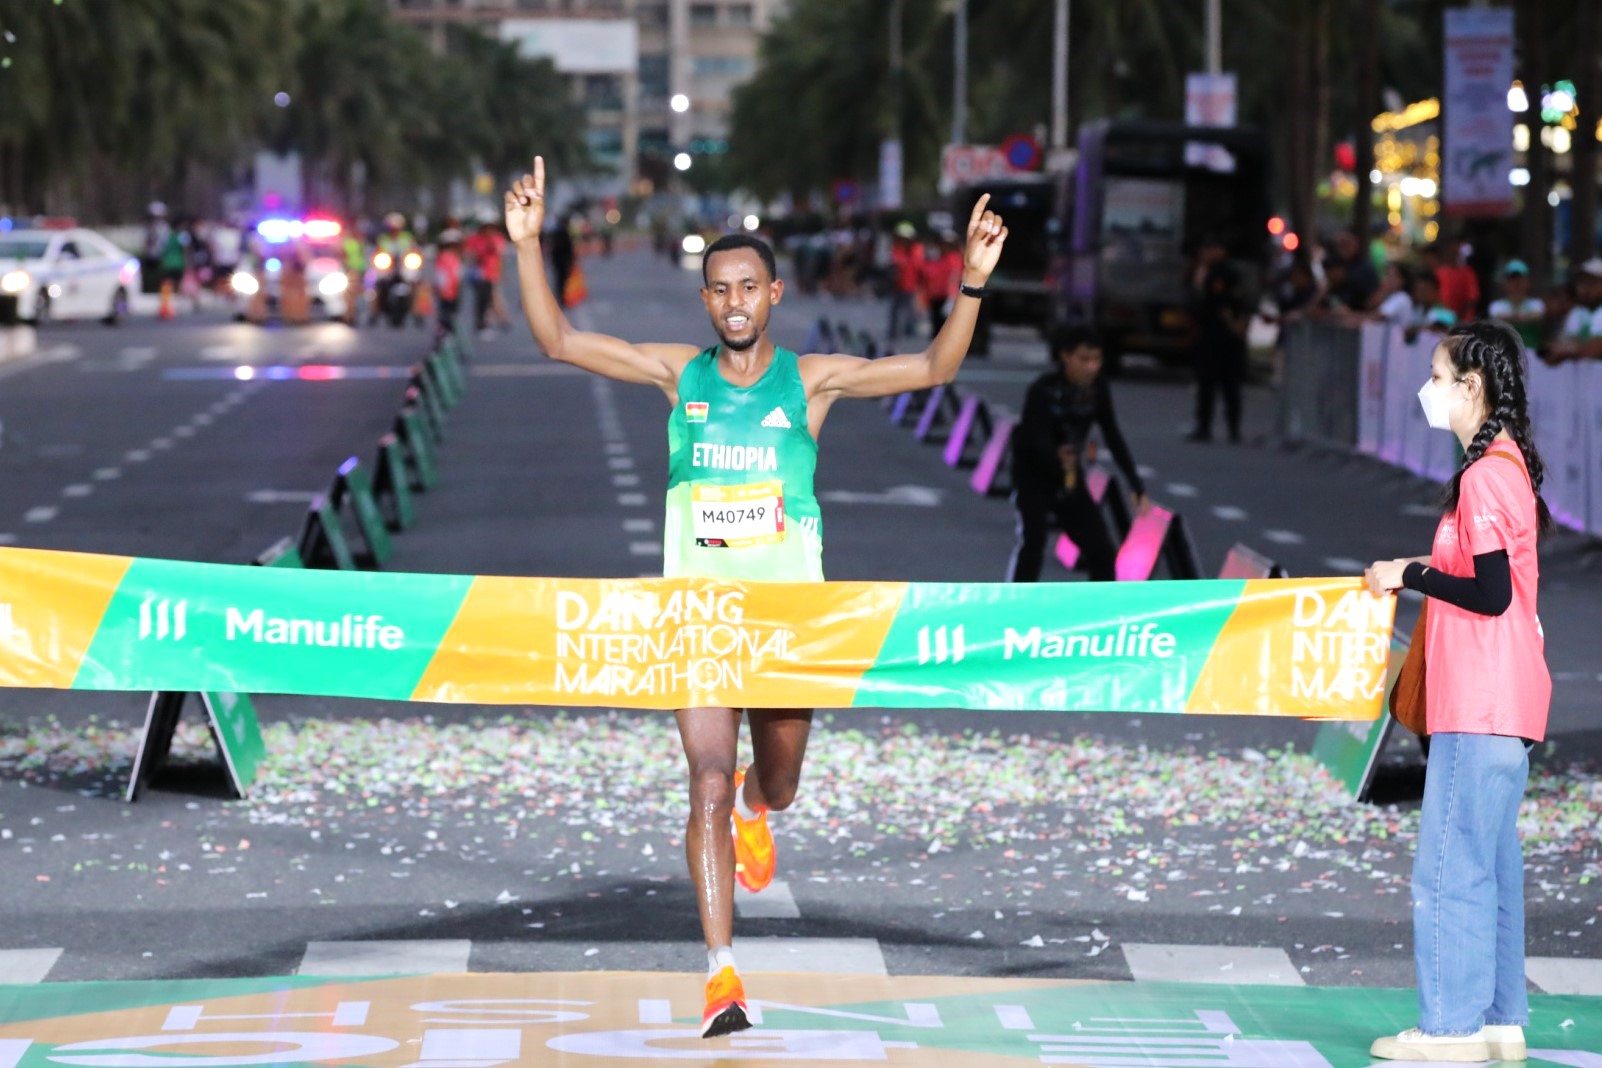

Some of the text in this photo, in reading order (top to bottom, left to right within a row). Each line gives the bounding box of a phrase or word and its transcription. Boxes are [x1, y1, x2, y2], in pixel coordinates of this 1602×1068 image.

[692, 442, 777, 471] ETHIOPIA
[702, 506, 765, 524] M40749
[225, 606, 405, 650] Manulife
[556, 589, 744, 631] DANANG
[556, 624, 799, 663] INTERNATIONAL
[1003, 622, 1177, 659] Manulife
[553, 657, 743, 696] MARATHON
[161, 999, 1242, 1034] FINISH
